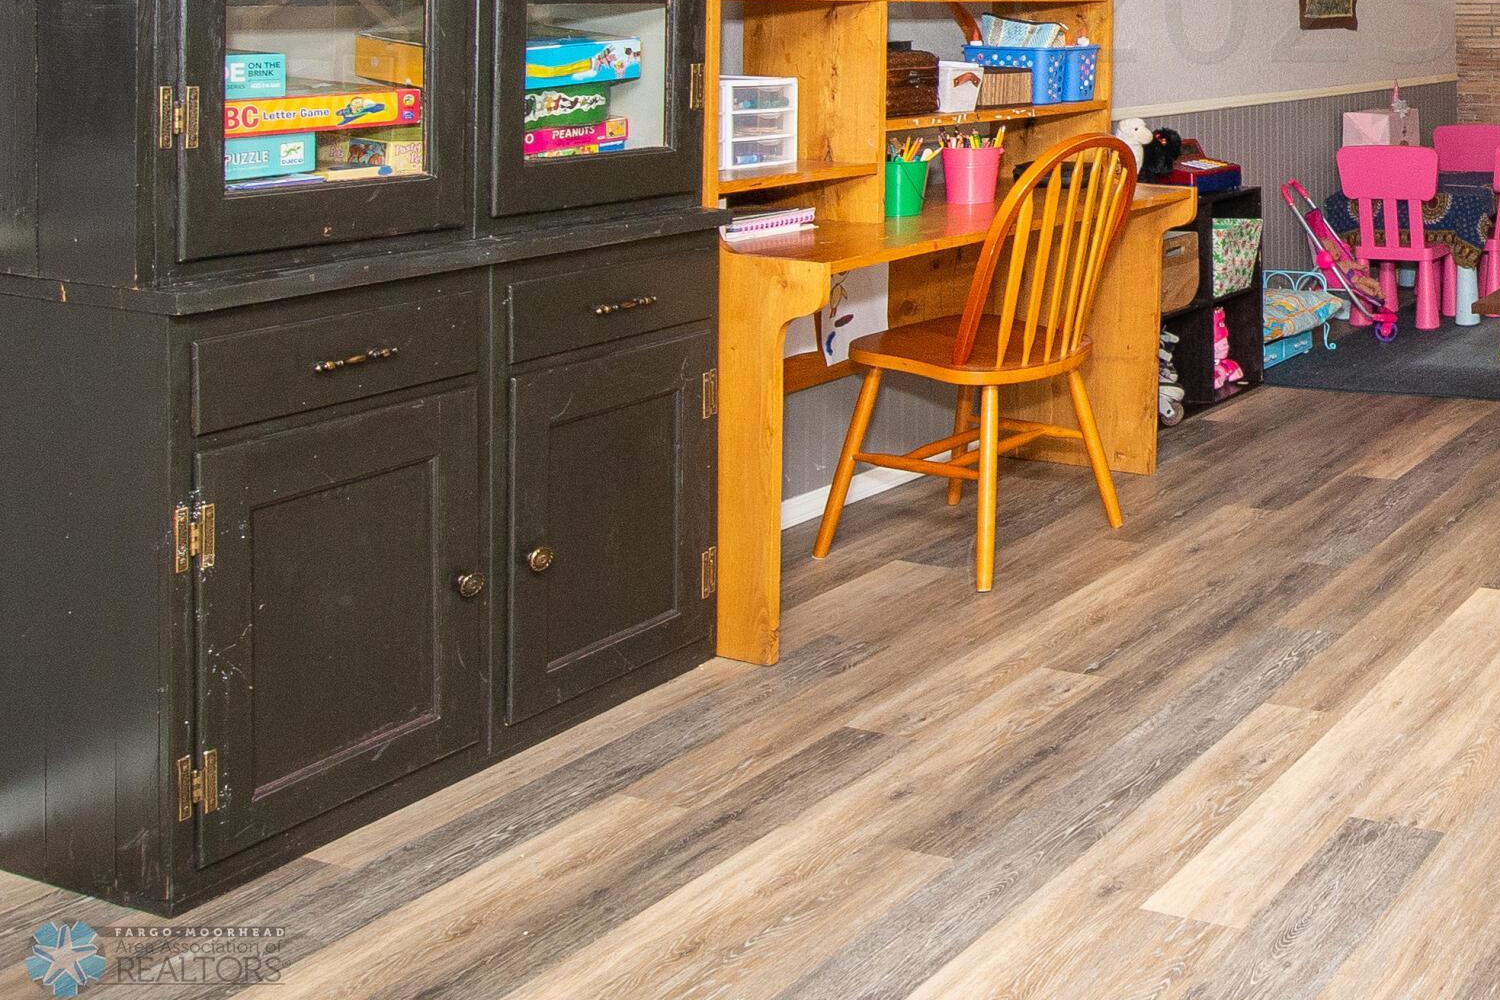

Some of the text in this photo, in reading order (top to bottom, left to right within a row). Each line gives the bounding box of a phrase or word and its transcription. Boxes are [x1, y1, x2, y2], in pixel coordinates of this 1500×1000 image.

[263, 109, 329, 121] Letter Game
[552, 126, 595, 140] PEANUTS
[225, 151, 270, 166] PUZZLE
